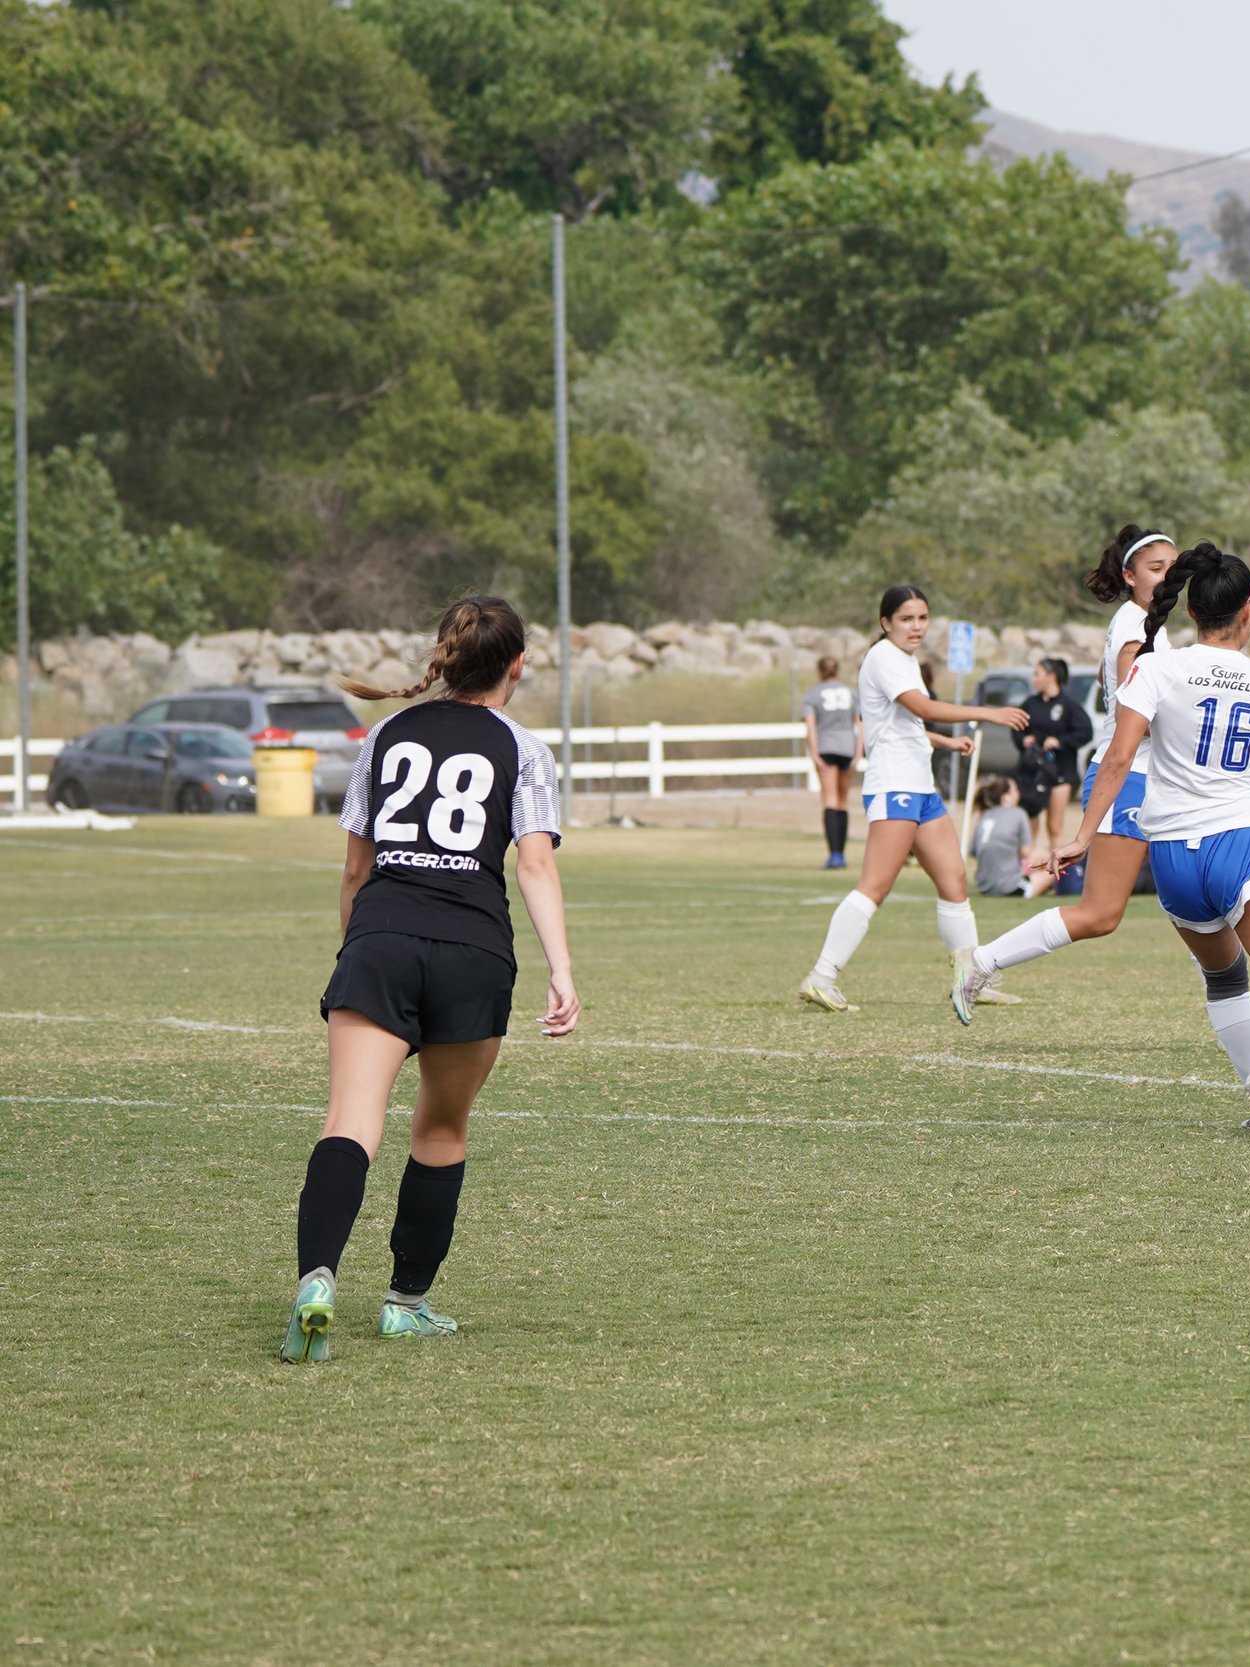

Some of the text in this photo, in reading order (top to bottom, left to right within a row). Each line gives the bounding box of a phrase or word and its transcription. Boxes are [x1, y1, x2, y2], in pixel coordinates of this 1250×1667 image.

[1218, 669, 1246, 680] SURF
[1187, 676, 1211, 687] LOS
[374, 741, 495, 851] 28
